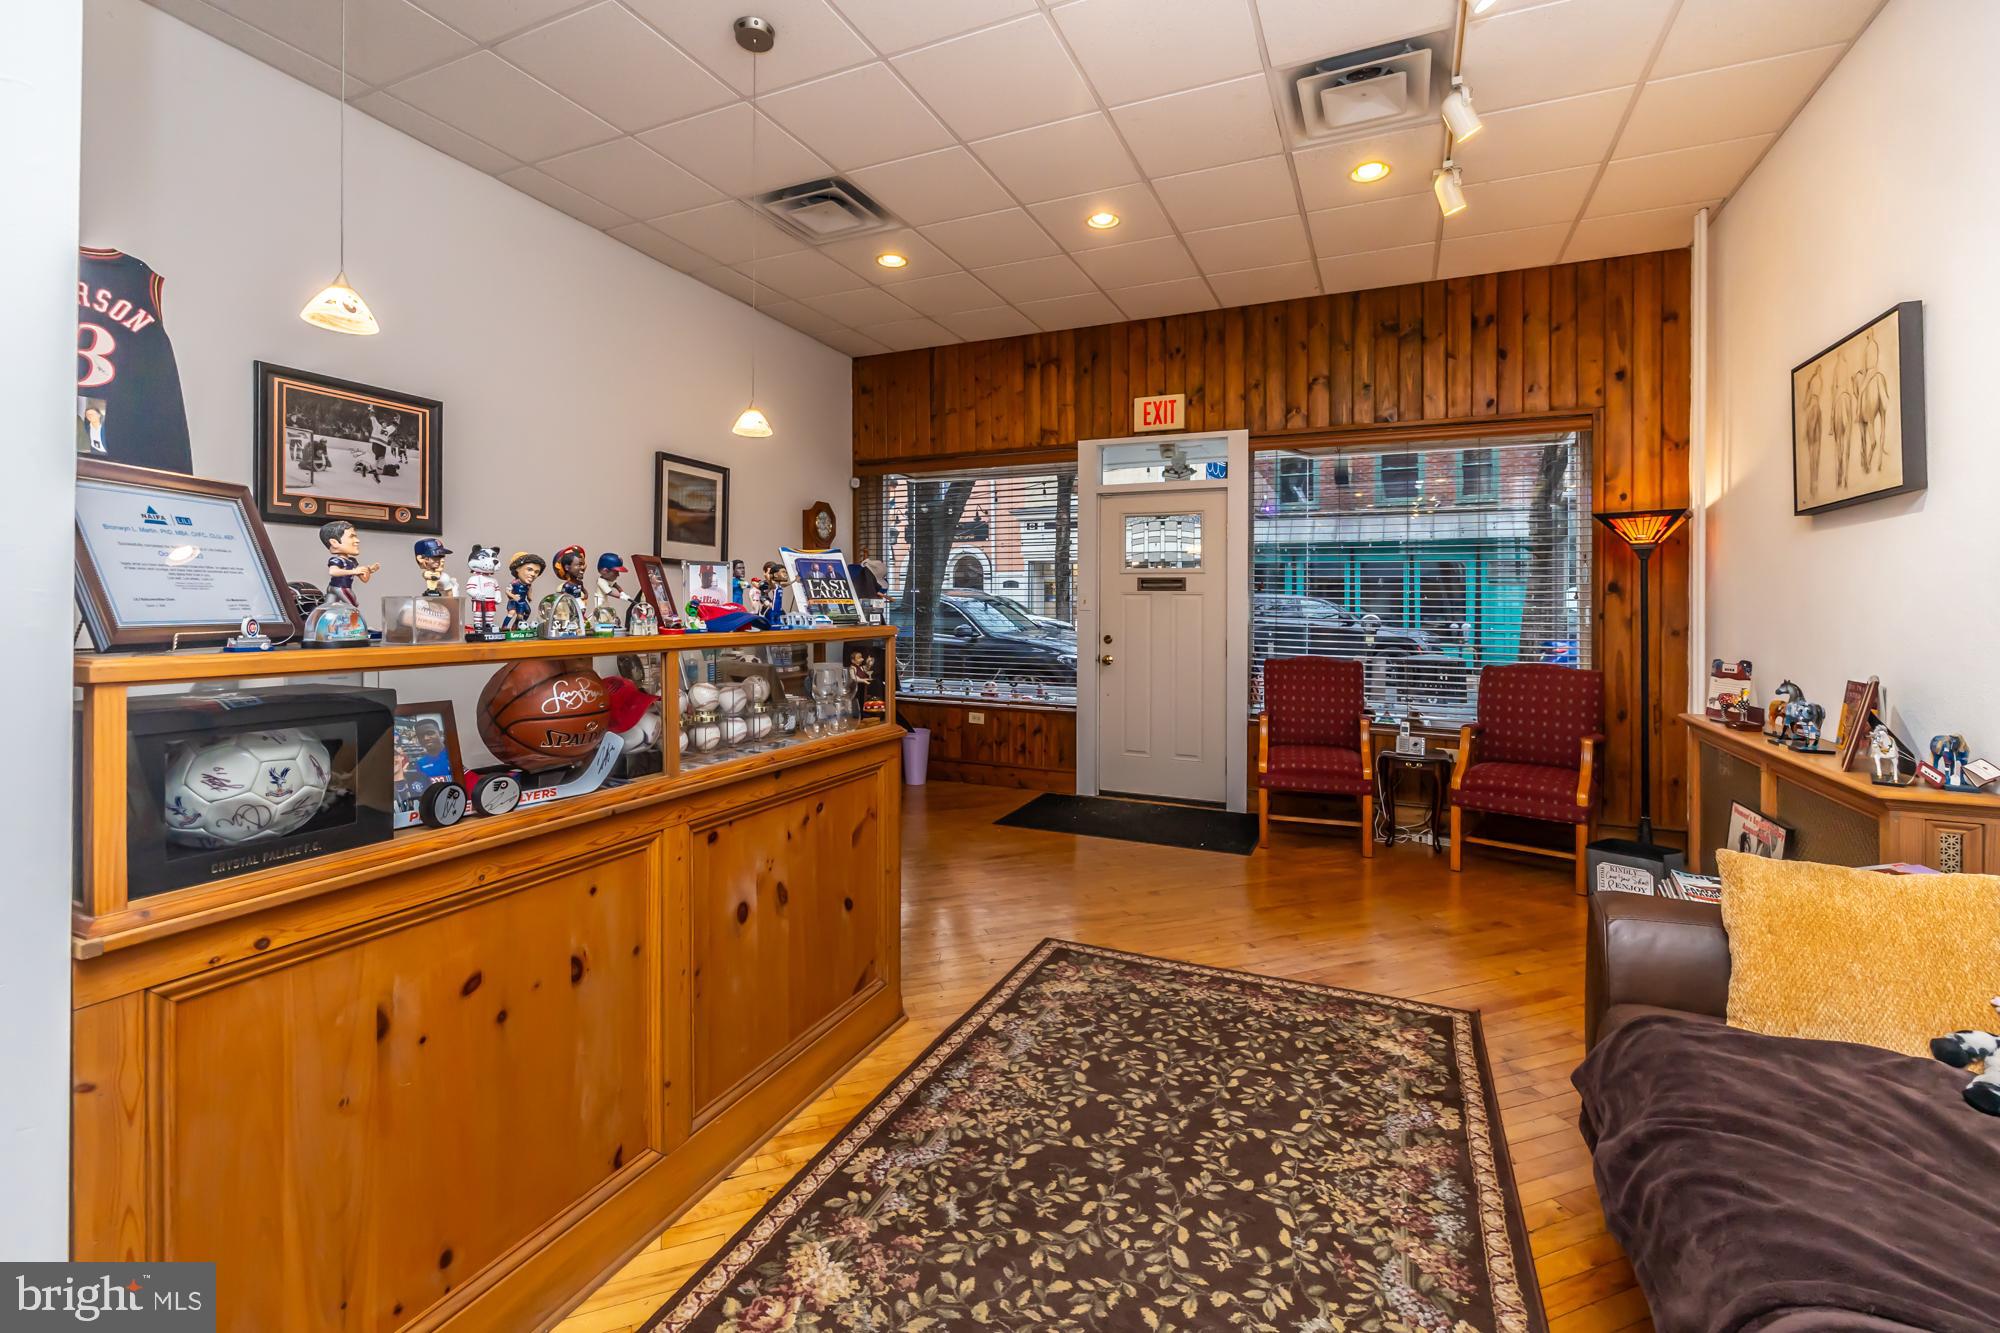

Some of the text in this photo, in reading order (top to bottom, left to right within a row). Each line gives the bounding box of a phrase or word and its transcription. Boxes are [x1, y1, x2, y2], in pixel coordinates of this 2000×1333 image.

[1143, 399, 1177, 426] EXIT
[808, 579, 847, 591] LAST
[810, 590, 850, 599] LAUGH
[211, 854, 259, 874] CRYSTAL
[263, 844, 302, 863] PALACE
[1609, 864, 1638, 876] KINDLY
[1615, 882, 1648, 893] ENJOY
